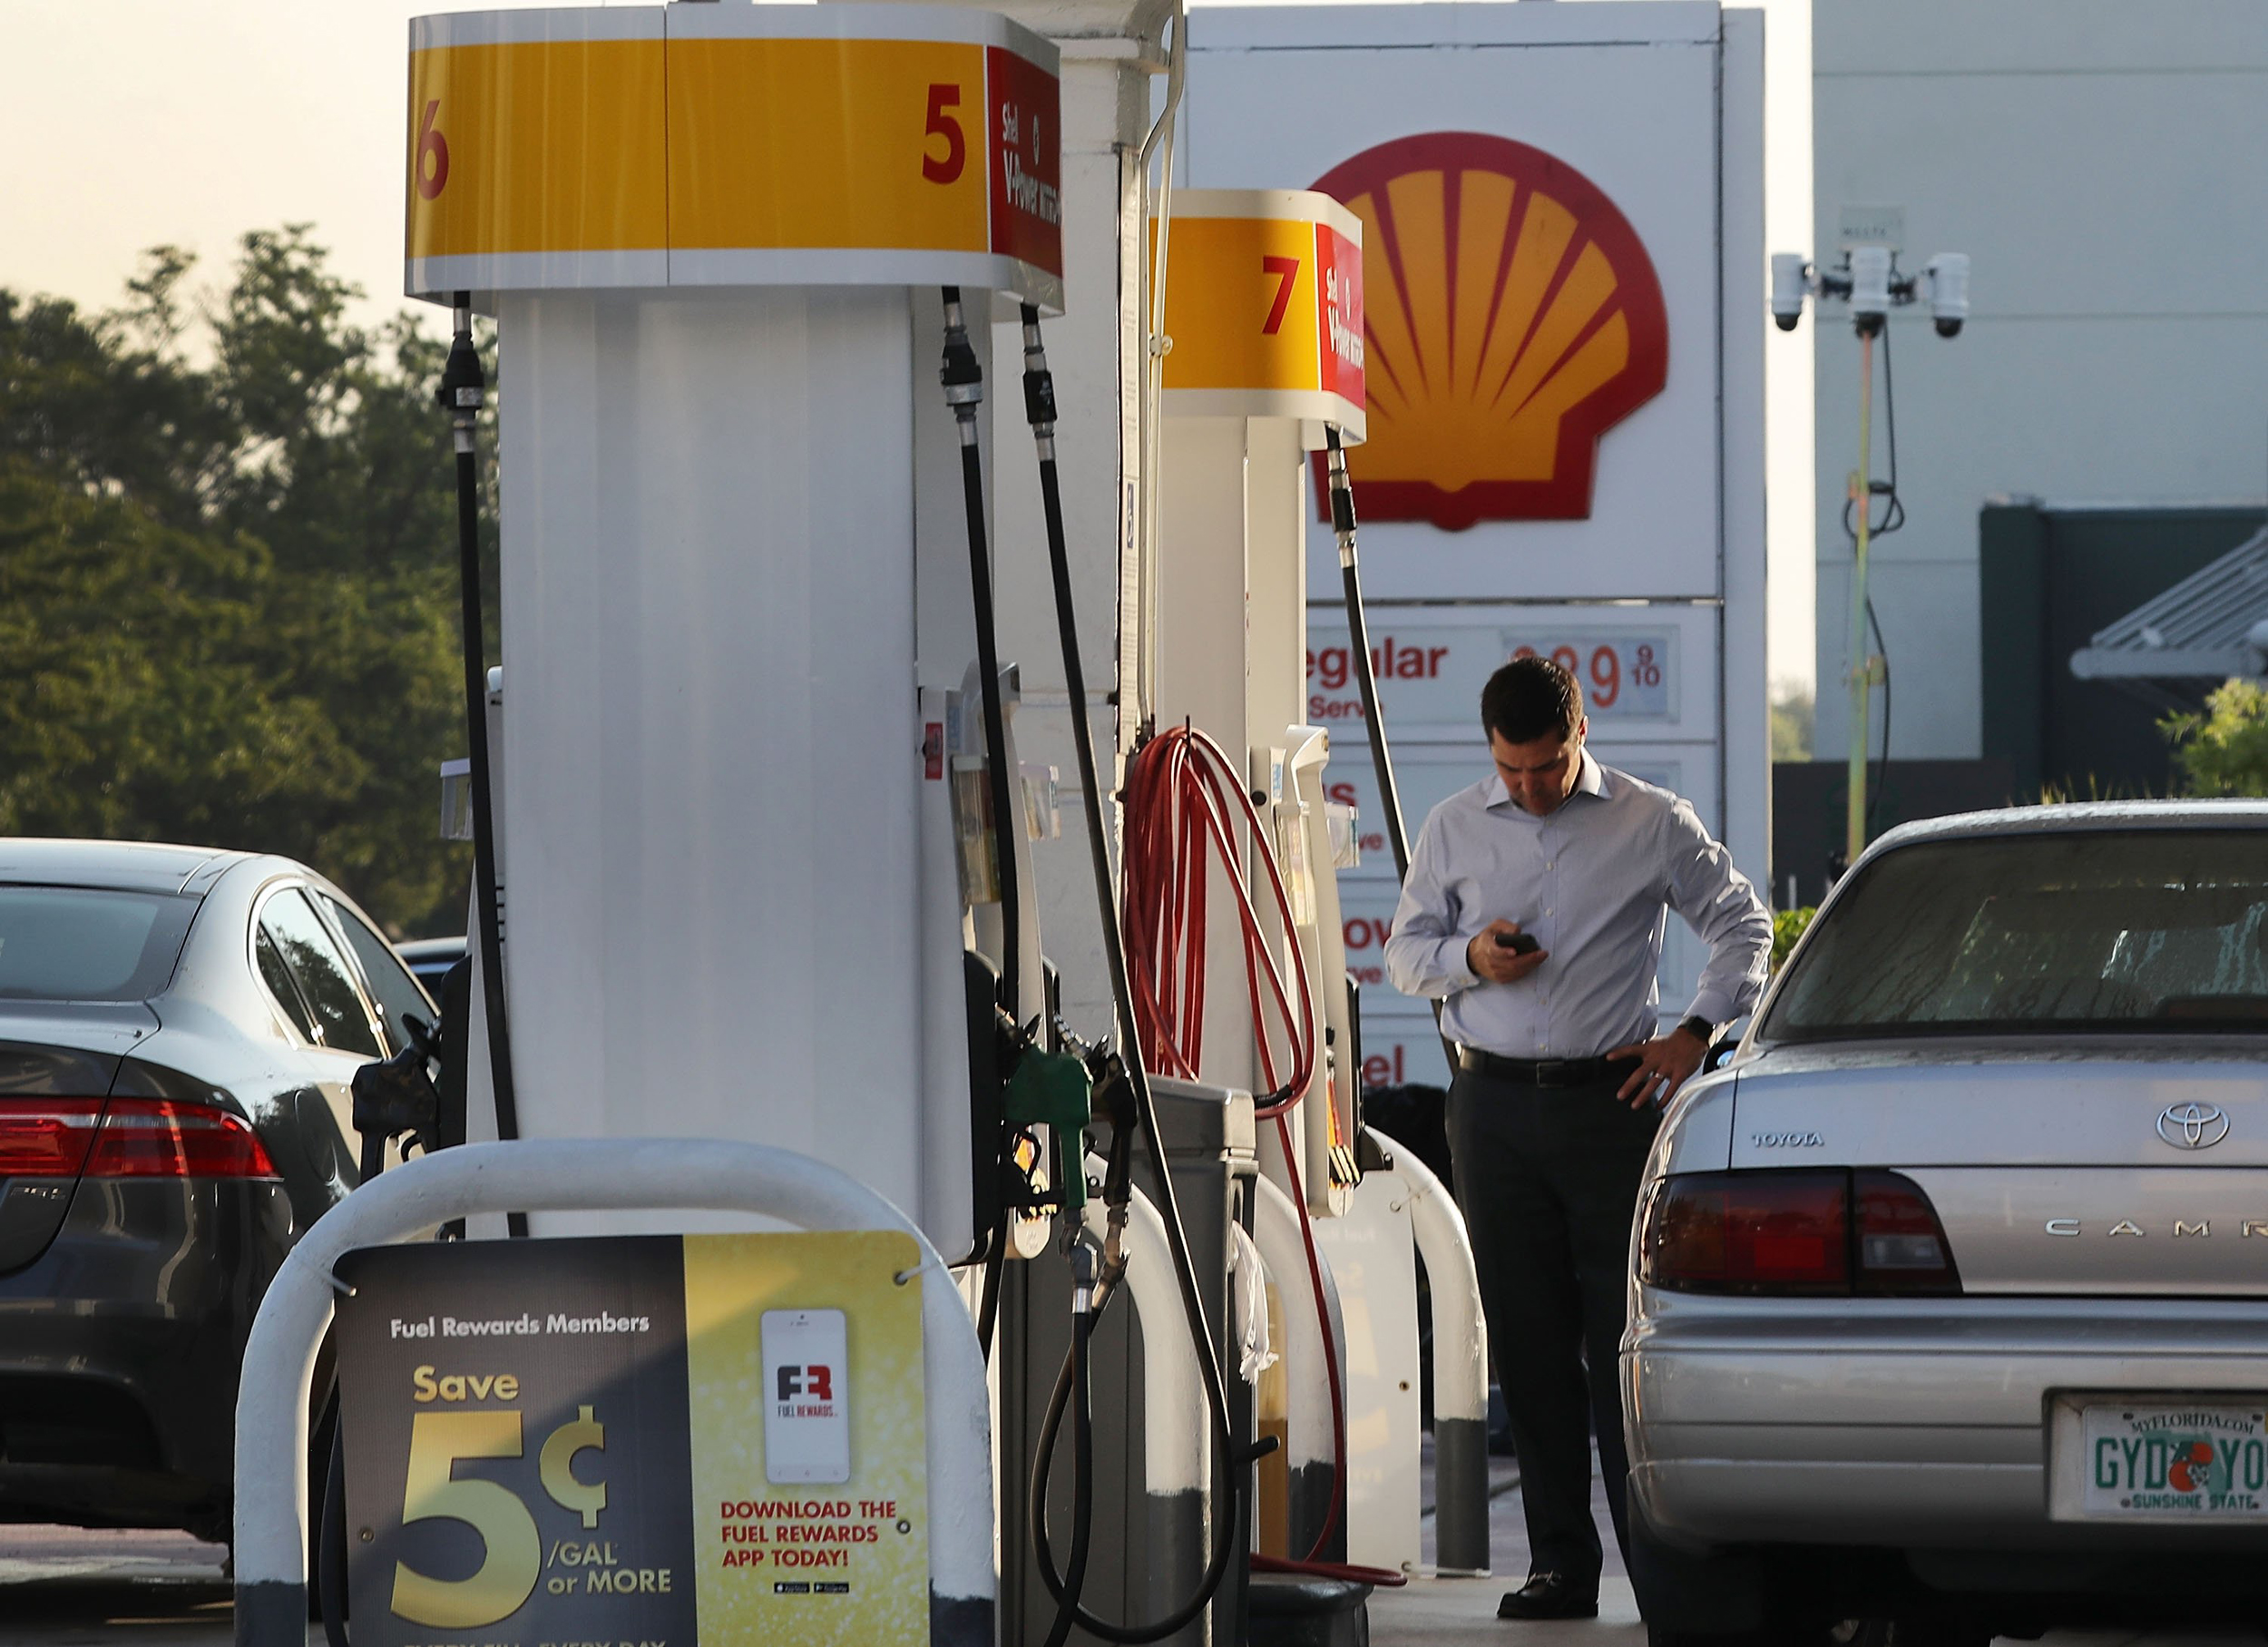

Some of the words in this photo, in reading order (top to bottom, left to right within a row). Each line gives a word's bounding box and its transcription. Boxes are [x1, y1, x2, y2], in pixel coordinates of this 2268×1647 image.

[922, 83, 965, 185] 5
[416, 98, 450, 201] 6
[1261, 255, 1301, 335] 7
[1632, 664, 1661, 687] 10
[1309, 695, 1384, 719] Serv
[1751, 1131, 1825, 1148] TOYOTA
[390, 1316, 435, 1339] Fuel
[442, 1313, 541, 1338] Rewards
[545, 1311, 650, 1334] Members
[413, 1365, 519, 1403] Save
[777, 1405, 795, 1417] FUEL
[2132, 1412, 2253, 1435] MYFLORIDA.COM
[2095, 1437, 2168, 1489] GYD
[720, 1501, 851, 1519] DOWNLOAD
[858, 1501, 895, 1518] THE
[2132, 1494, 2202, 1510] SUNSHINE
[2208, 1494, 2253, 1510] STATE
[721, 1525, 768, 1544] FUEL
[776, 1525, 878, 1543] REWARDS
[547, 1541, 618, 1568] /GAL
[722, 1549, 764, 1568] APP
[771, 1549, 848, 1568] TODAY!
[547, 1577, 578, 1594] or
[586, 1568, 671, 1594] MORE
